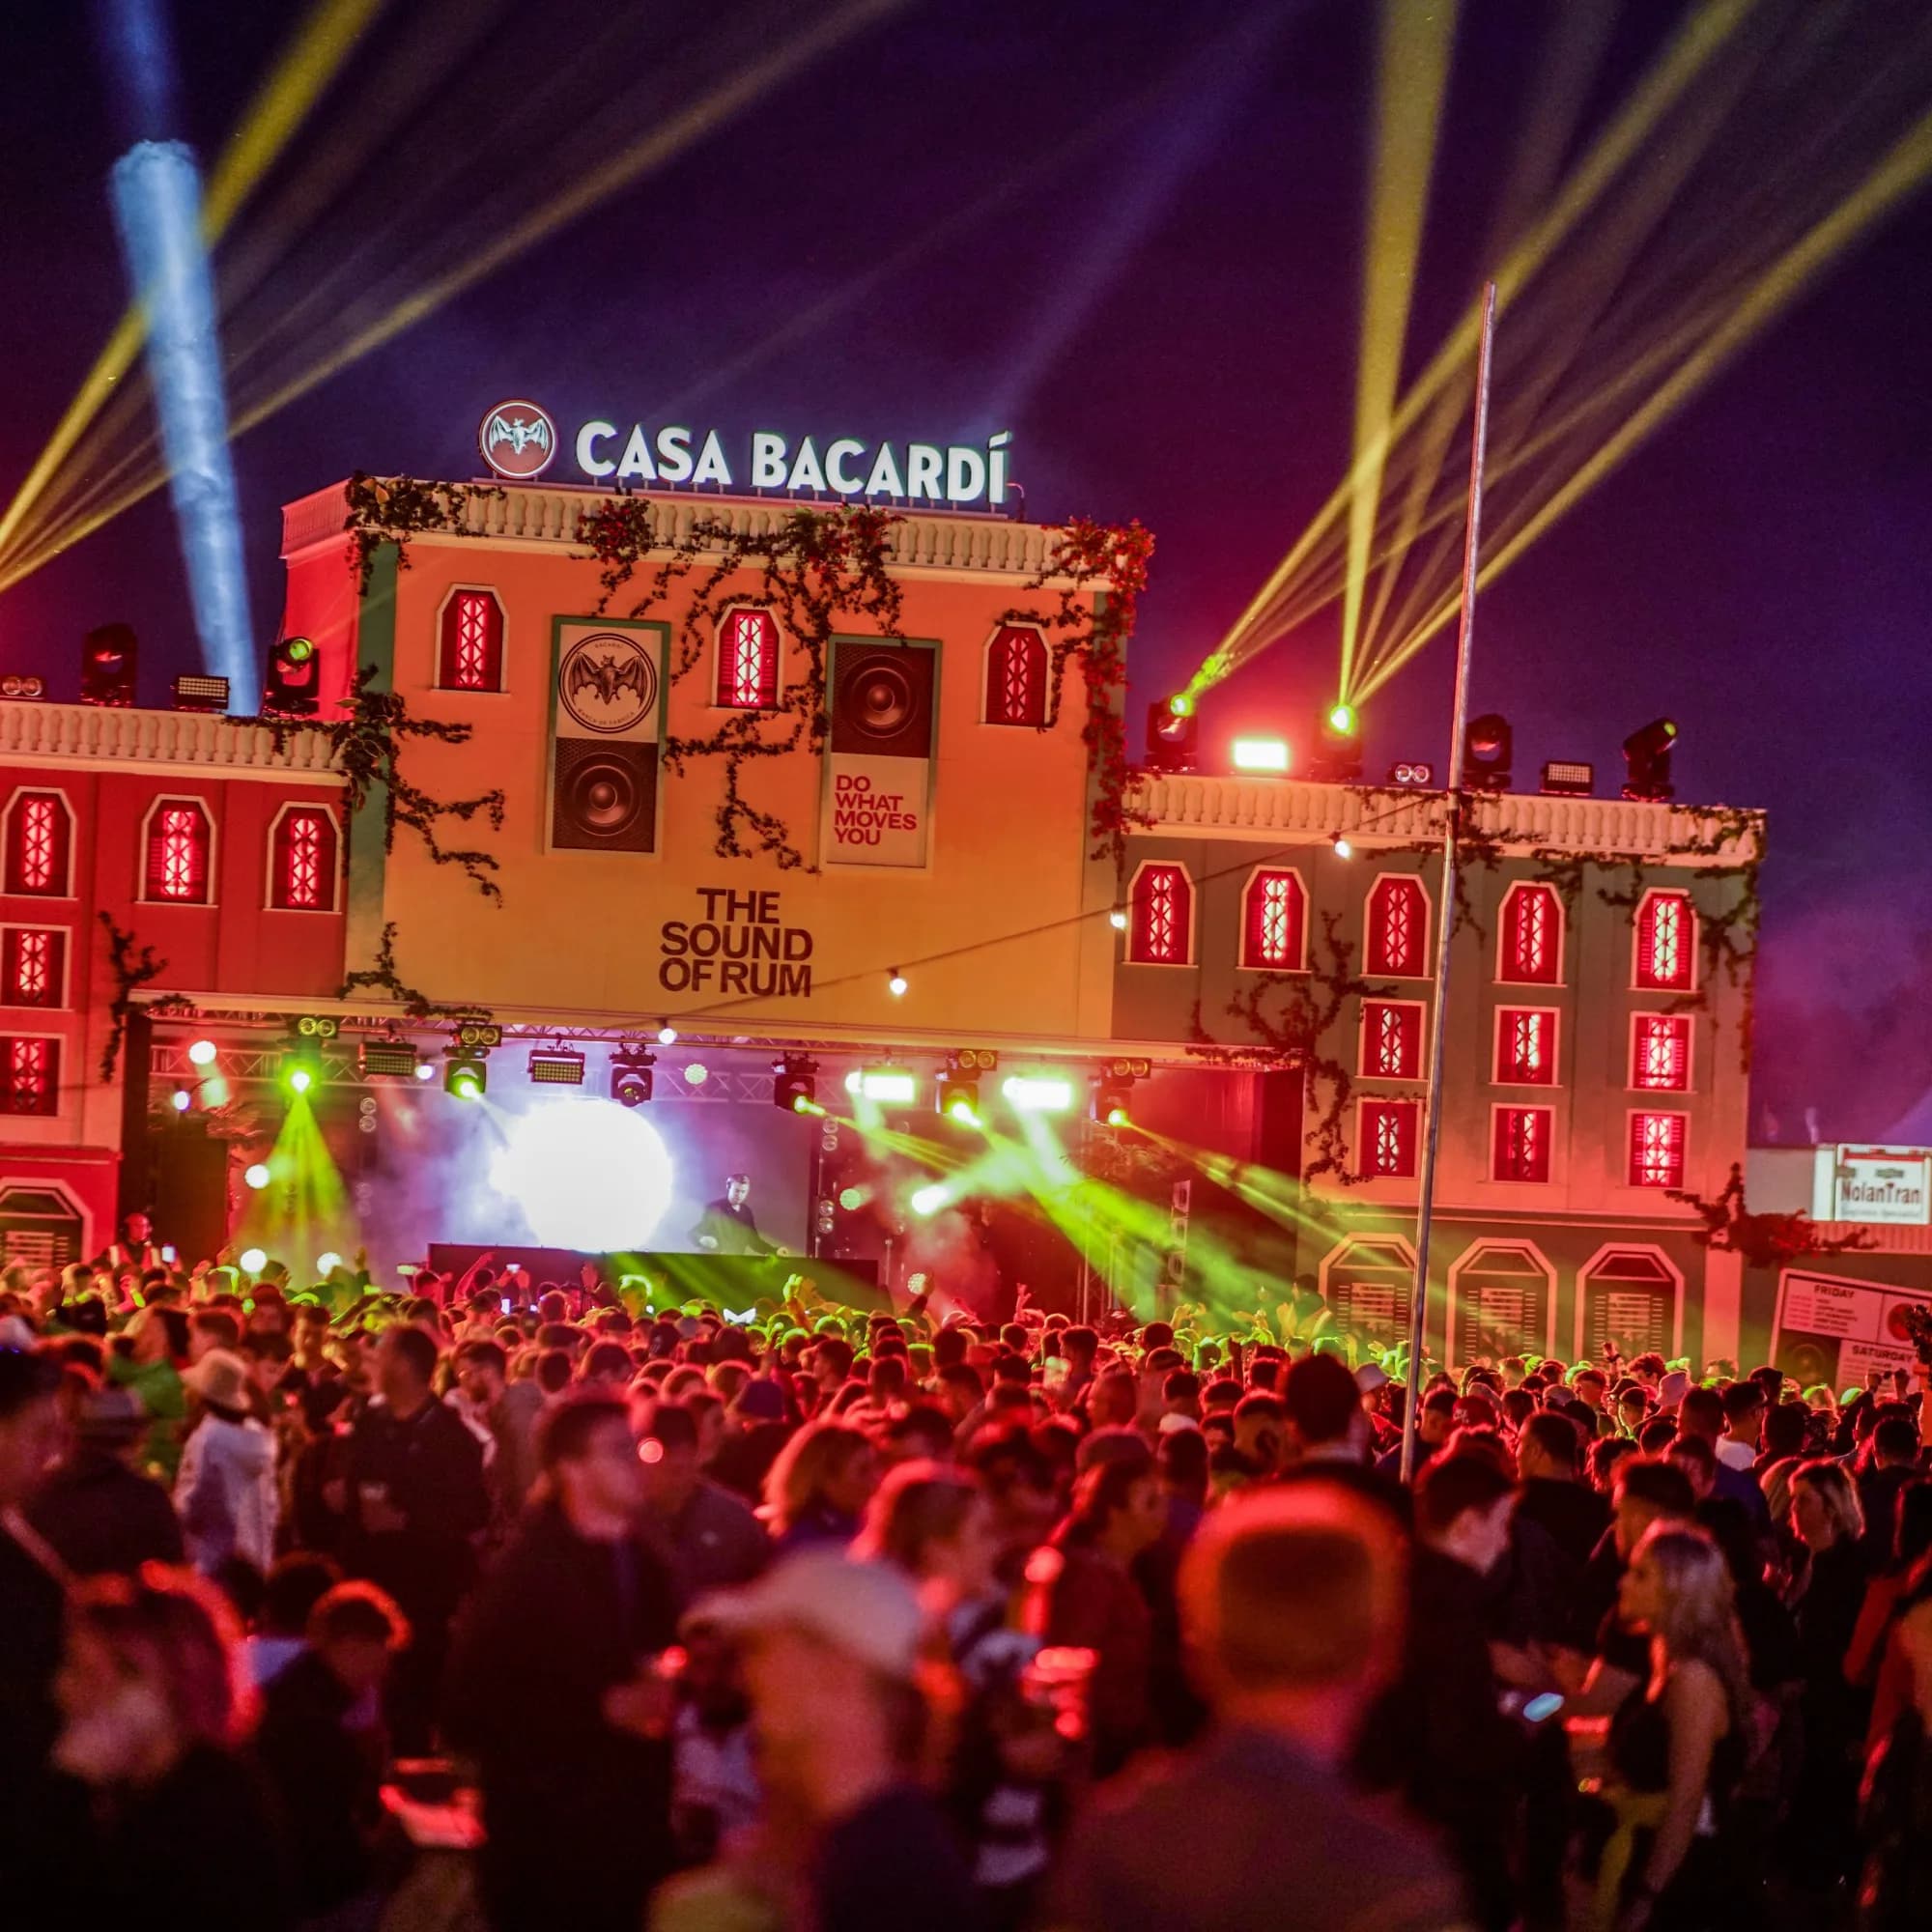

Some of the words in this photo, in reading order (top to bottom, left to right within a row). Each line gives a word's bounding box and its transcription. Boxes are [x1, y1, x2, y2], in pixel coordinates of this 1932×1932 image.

[576, 421, 732, 485] CASA
[752, 430, 1011, 503] BACARDÍ
[836, 775, 871, 792] DO
[835, 792, 903, 812] WHAT
[835, 810, 918, 831] MOVES
[835, 826, 881, 846] YOU
[696, 887, 781, 924] THE
[660, 921, 813, 961] SOUND
[659, 957, 714, 992] OF
[720, 960, 811, 998] RUM
[1813, 1284, 1856, 1299] FRIDAY
[1852, 1344, 1914, 1363] SATURDAY
